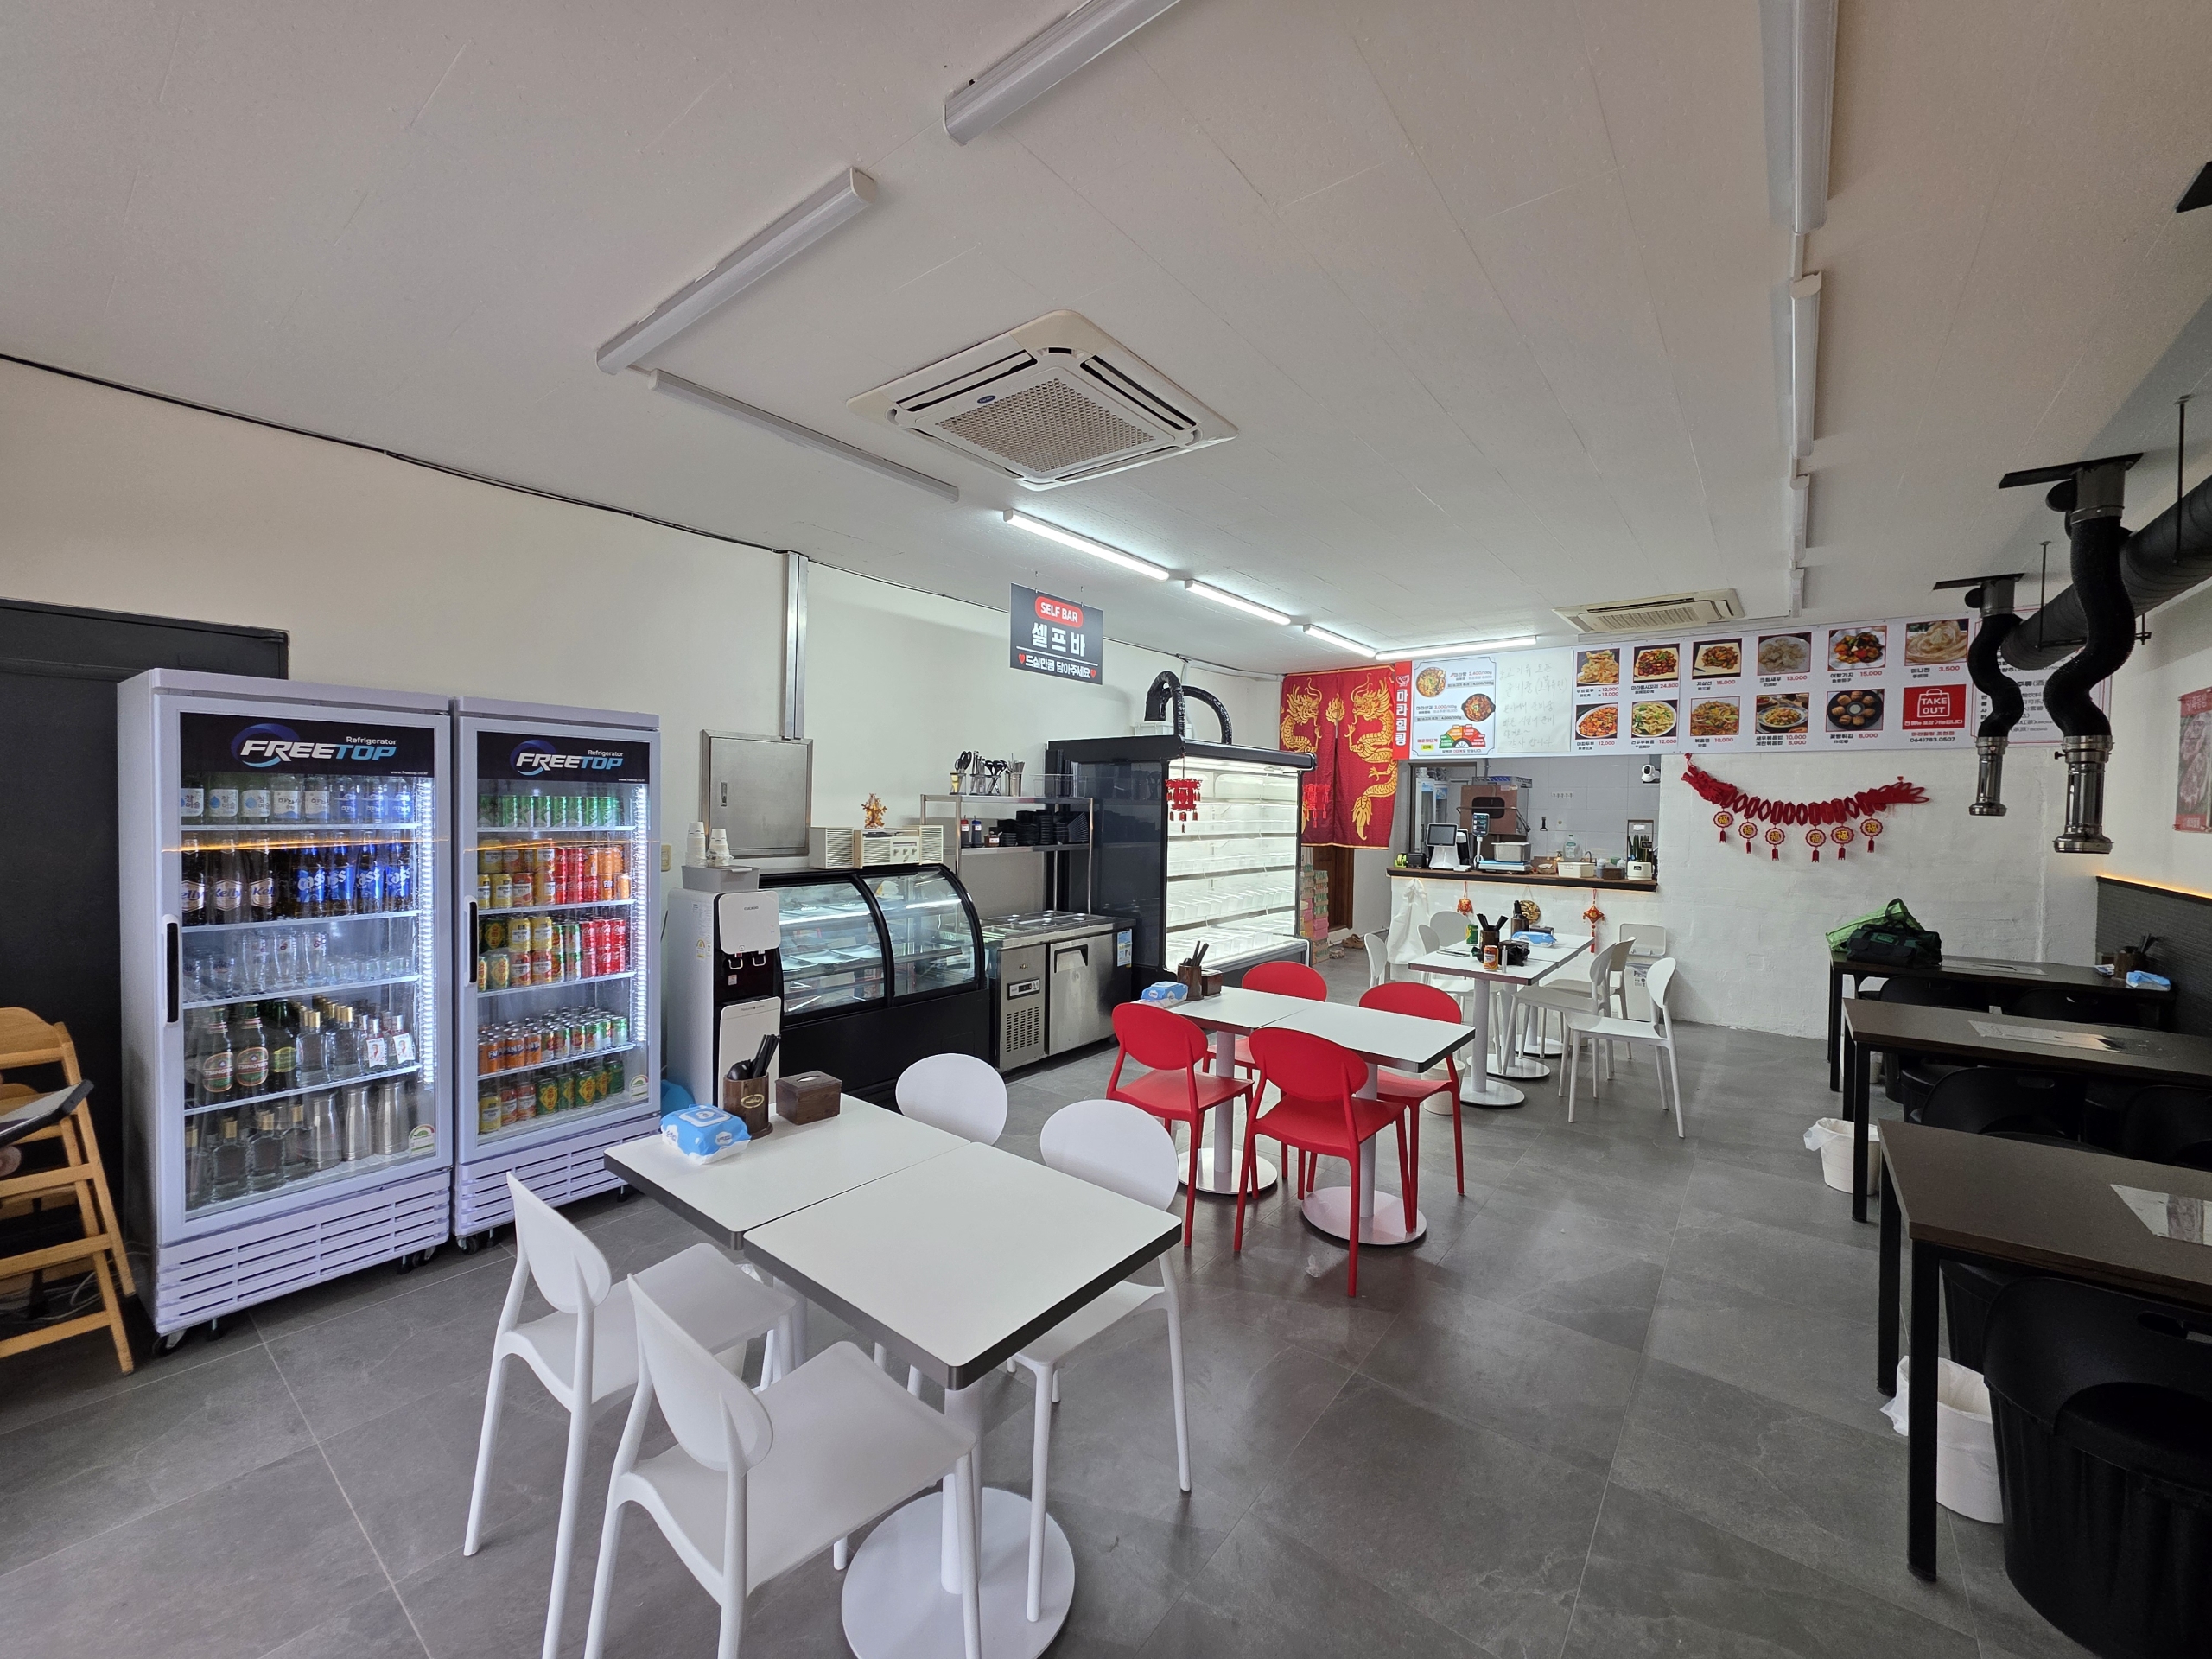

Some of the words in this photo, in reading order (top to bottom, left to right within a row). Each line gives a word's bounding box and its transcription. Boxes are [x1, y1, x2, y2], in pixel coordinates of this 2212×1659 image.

[1040, 602, 1061, 618] SELF
[1062, 608, 1078, 623] BAR
[1032, 622, 1085, 657] 셀프바
[1025, 654, 1055, 671] 드실만큼
[1056, 661, 1090, 678] 담아주세요
[1395, 689, 1408, 746] 마라힐링
[346, 736, 397, 746] Refrigerator
[240, 740, 397, 762] FREETOP
[516, 753, 624, 771] FREETOP
[1719, 815, 1729, 823] 福
[1744, 826, 1752, 835] 福
[1866, 823, 1878, 832] 福
[1770, 831, 1780, 841] 福
[1811, 833, 1821, 842] 福
[1837, 830, 1848, 841] 福
[181, 890, 205, 901] elly
